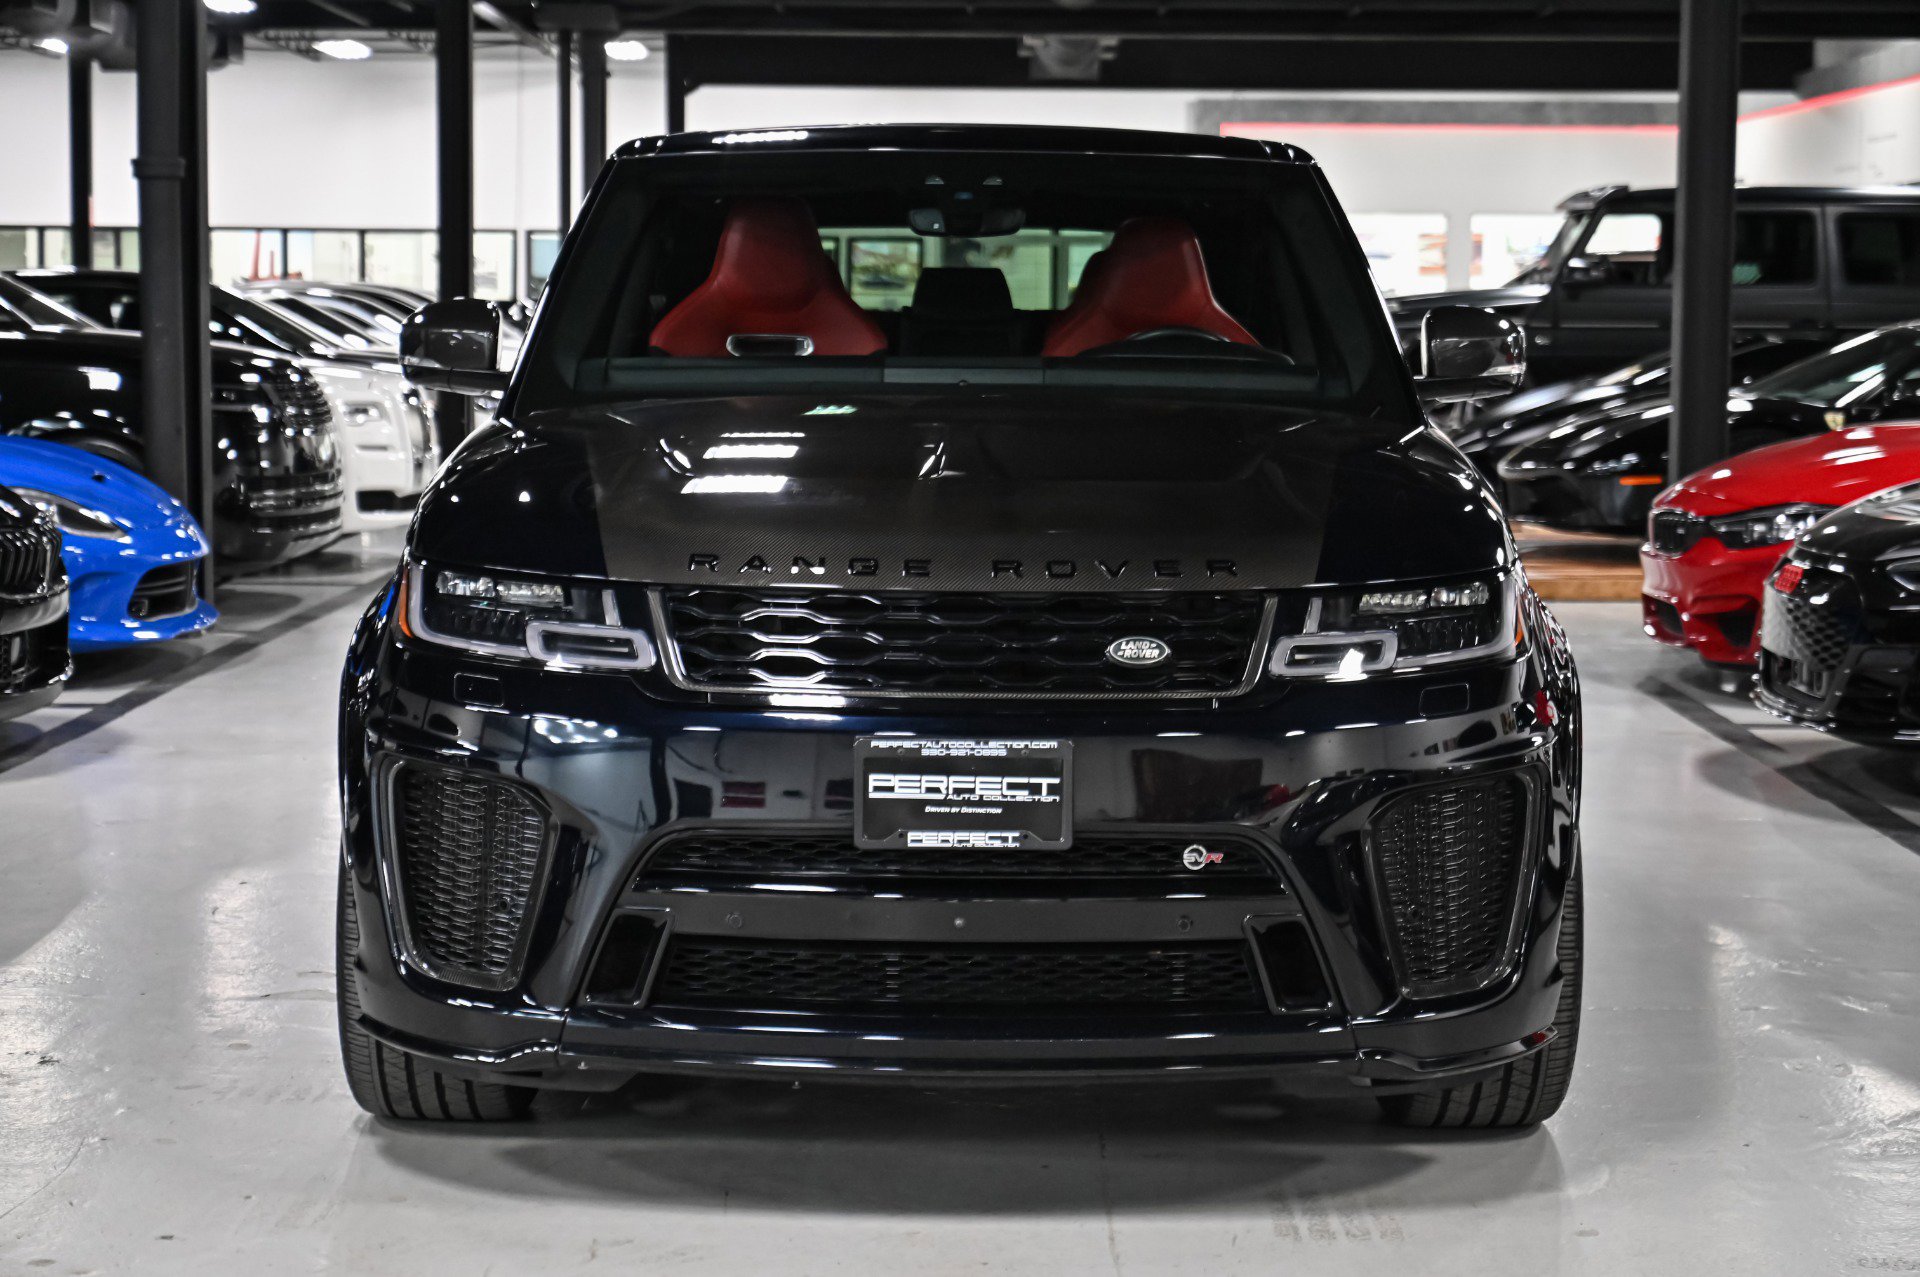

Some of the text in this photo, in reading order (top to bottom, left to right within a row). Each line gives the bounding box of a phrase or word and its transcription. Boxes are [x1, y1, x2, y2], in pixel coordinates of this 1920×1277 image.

[687, 552, 1239, 579] RANGE ROVER
[1120, 641, 1150, 650] LAND
[1123, 649, 1160, 659] ROVER
[868, 773, 1061, 797] PERFECT
[983, 795, 1060, 803] COLLECTION
[908, 831, 1021, 844] PERFECT
